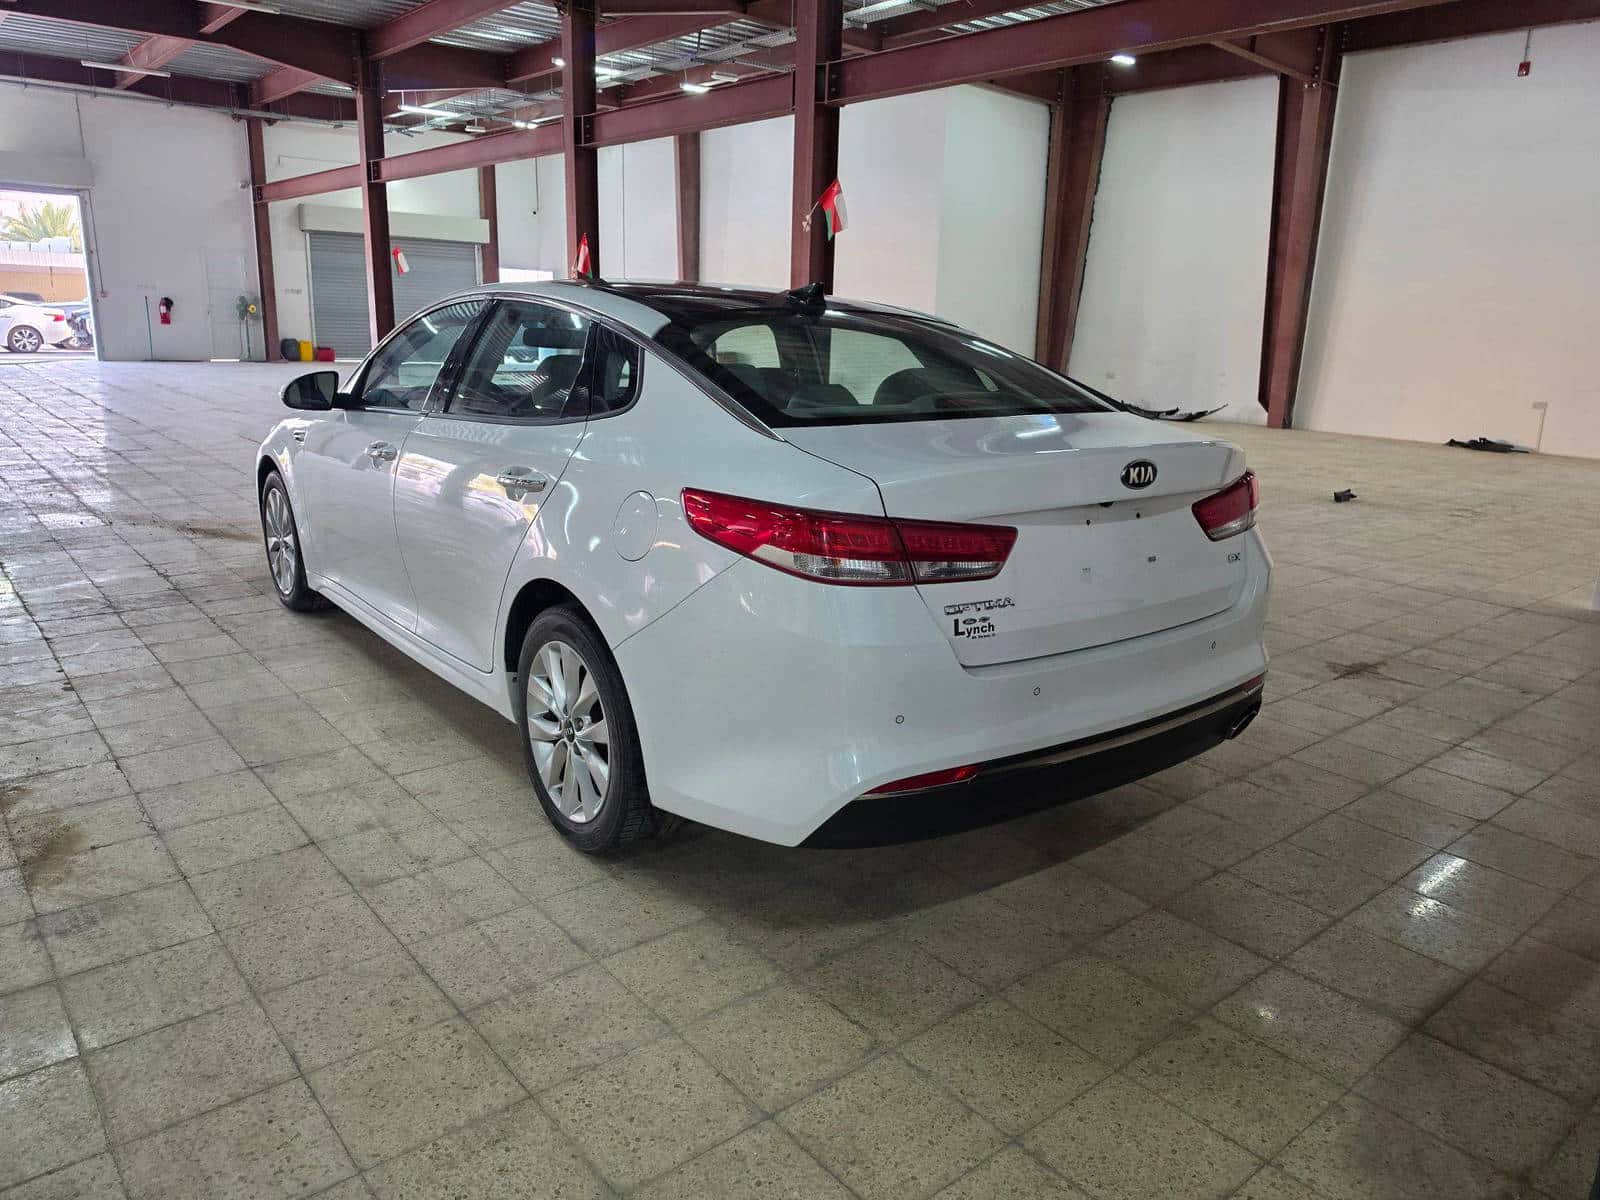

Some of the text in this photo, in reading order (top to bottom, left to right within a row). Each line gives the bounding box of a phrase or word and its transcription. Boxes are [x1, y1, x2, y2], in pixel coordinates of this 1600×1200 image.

[1129, 465, 1154, 485] KIA
[944, 597, 1015, 615] OPTIMA
[954, 618, 995, 638] Lynch
